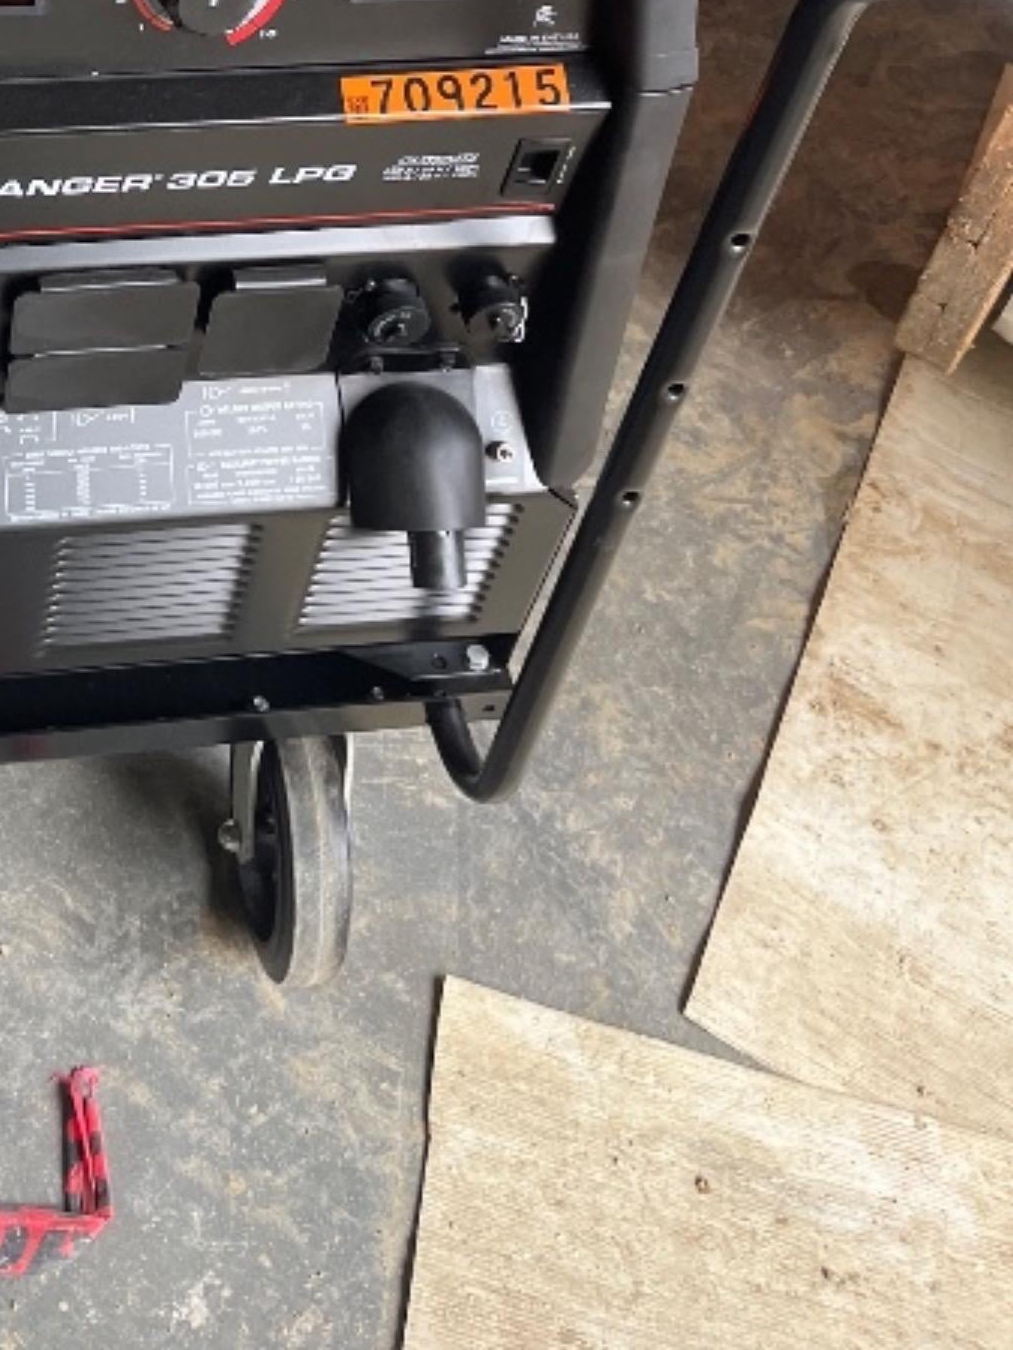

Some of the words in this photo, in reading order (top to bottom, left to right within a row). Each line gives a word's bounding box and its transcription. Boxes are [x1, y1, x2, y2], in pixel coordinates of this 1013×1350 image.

[370, 68, 561, 116] 709215
[166, 168, 258, 191] 305
[268, 163, 358, 185] LPG
